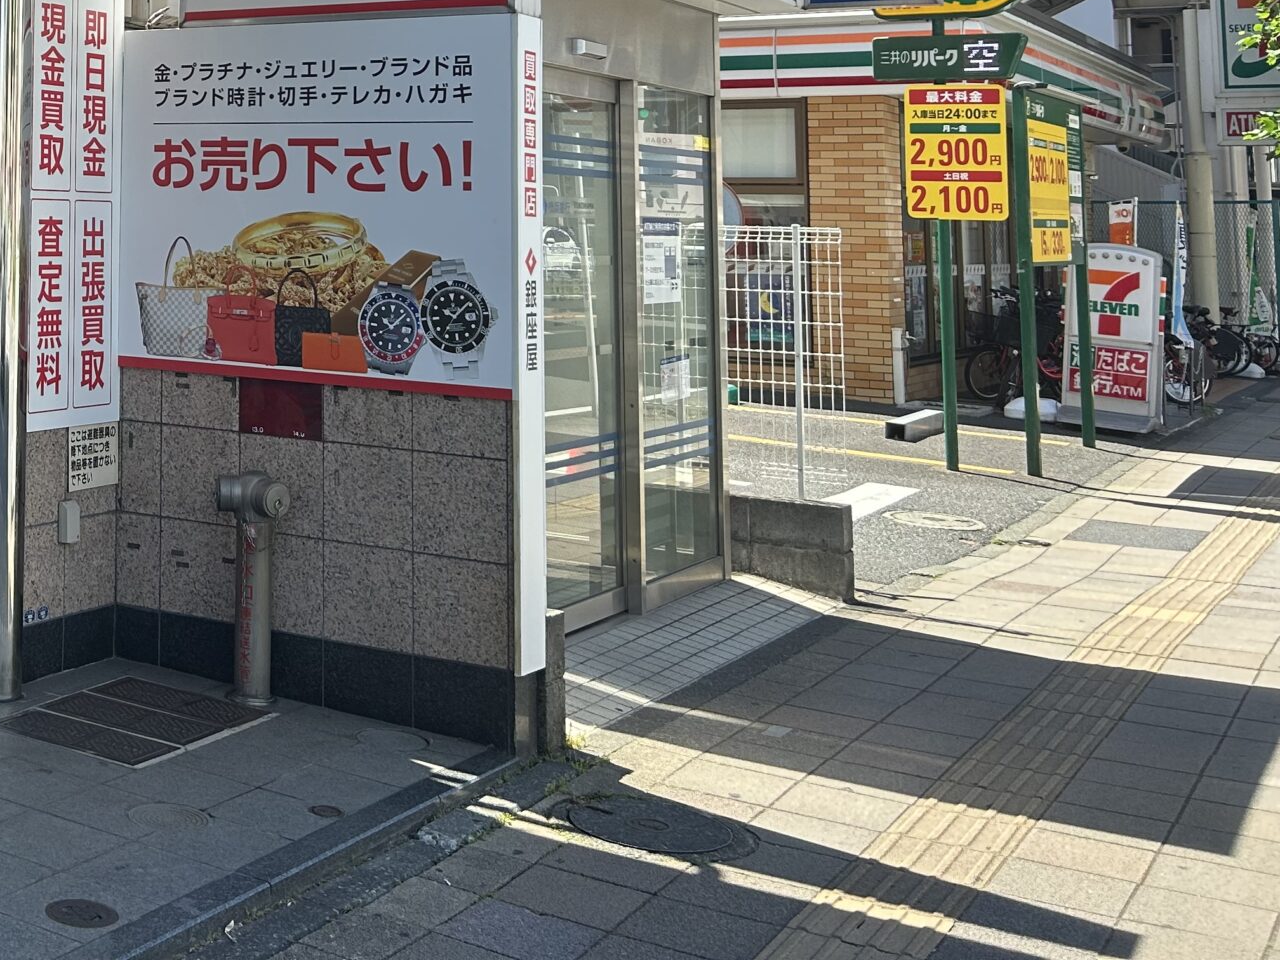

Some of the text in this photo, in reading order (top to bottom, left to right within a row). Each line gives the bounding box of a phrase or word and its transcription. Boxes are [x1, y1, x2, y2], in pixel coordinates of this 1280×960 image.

[153, 55, 473, 84] 金・プラチナ・ジュエリー・ブランド品
[880, 48, 958, 67] 三井のリパーク
[963, 41, 1000, 71] 空
[39, 2, 66, 175] 現金買取
[82, 10, 108, 176] 即日現金
[154, 83, 473, 108] ブランド時計・切手・テレカ・ハガキ
[925, 90, 983, 103] 最大料金
[912, 108, 998, 120] 入庫当日24:00まで
[524, 53, 537, 215] 買取専門店
[152, 136, 473, 194] お売り下さい!
[910, 138, 1002, 168] 2,900円
[943, 172, 969, 180] 土日祝
[911, 185, 1003, 215] 2,100円
[35, 216, 64, 397] 査定無料
[80, 217, 106, 391] 出張買取
[525, 279, 538, 371] 銀座屋
[1098, 349, 1146, 374] たばこ
